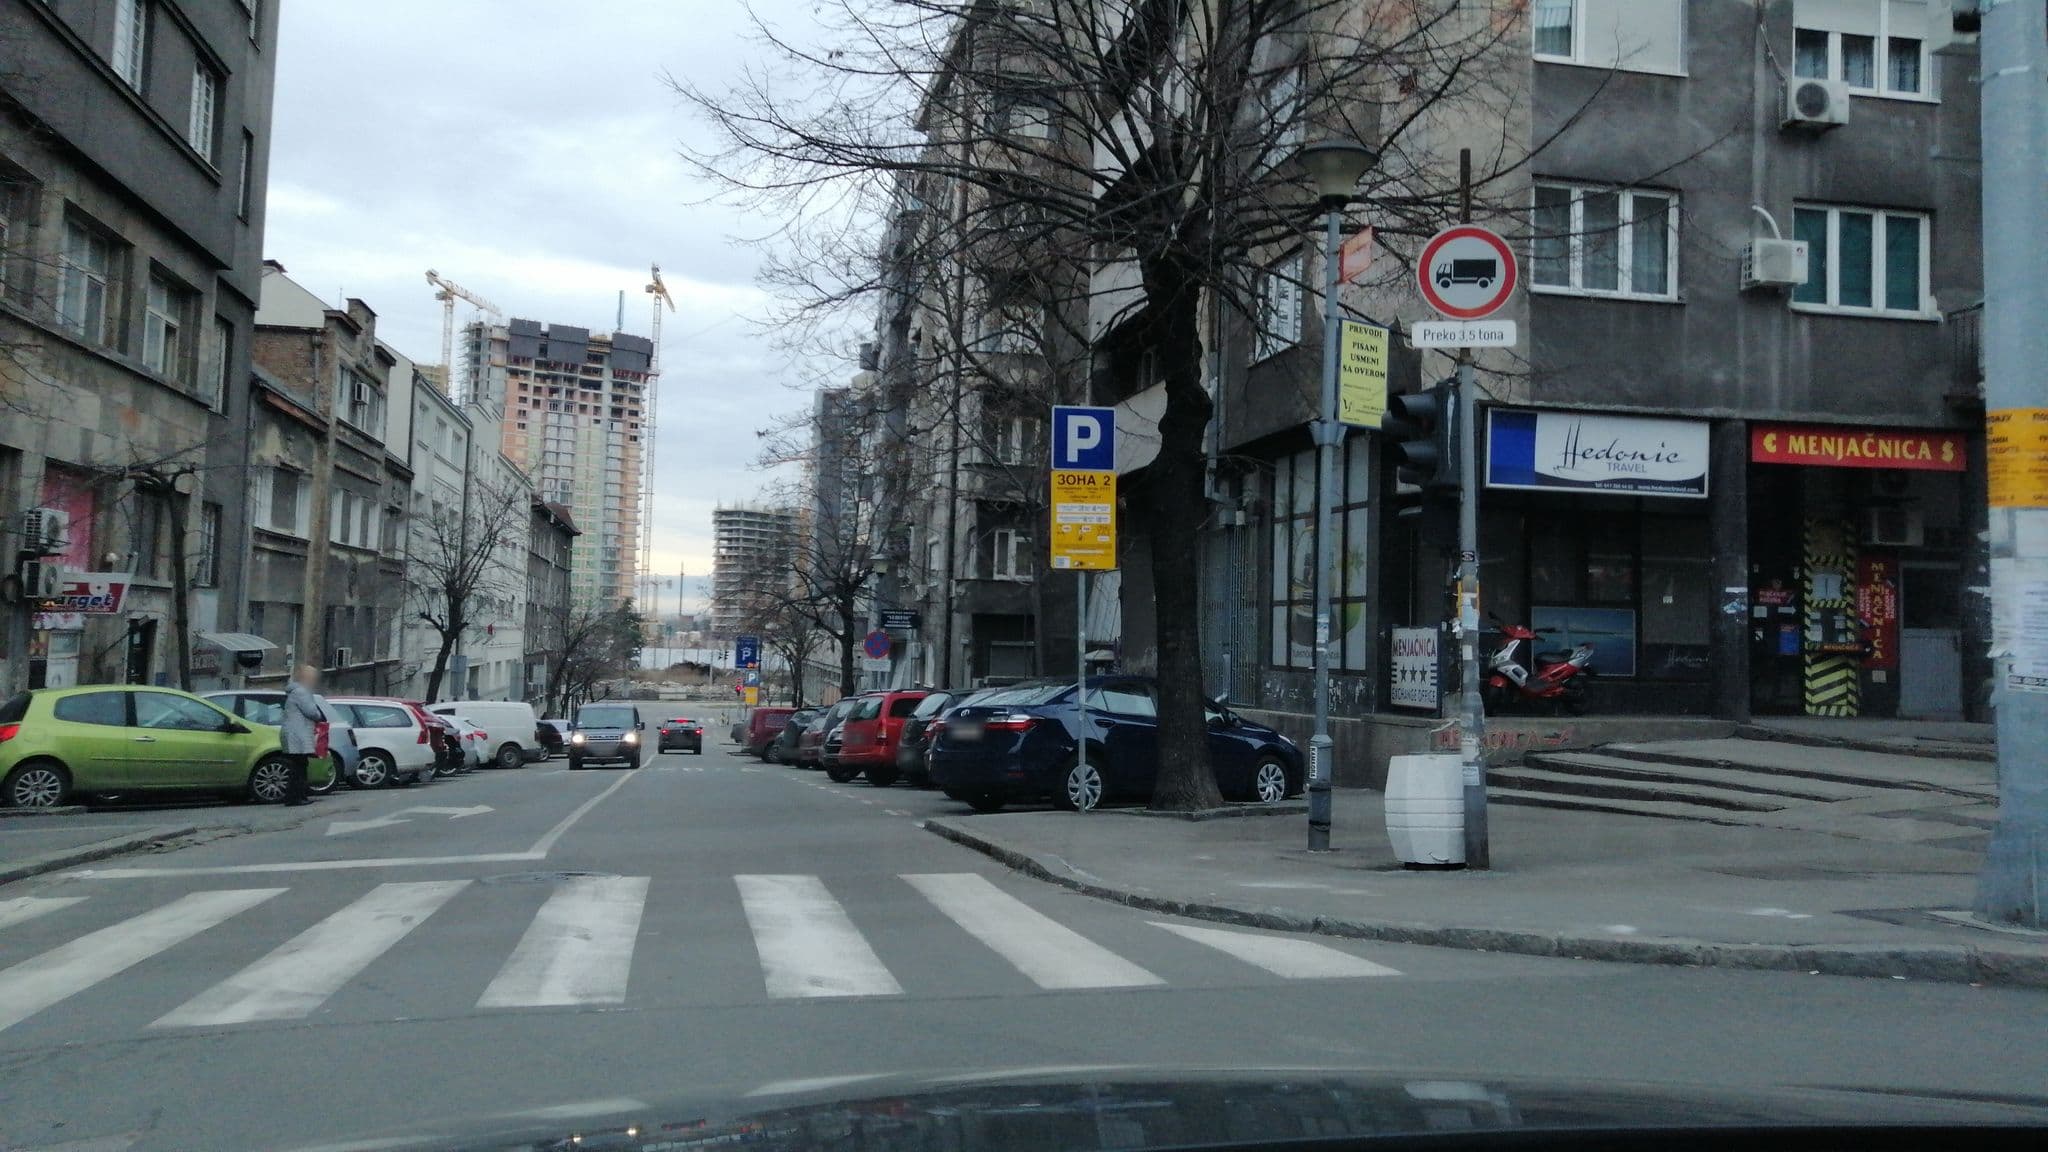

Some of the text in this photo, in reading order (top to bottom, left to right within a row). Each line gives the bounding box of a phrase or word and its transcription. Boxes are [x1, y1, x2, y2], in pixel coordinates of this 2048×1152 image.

[1349, 325, 1383, 338] PREVODI
[1423, 328, 1504, 342] Preko 3,5 tona
[1352, 341, 1378, 353] PISANI
[1350, 353, 1379, 366] USMENI
[1343, 365, 1386, 378] SA OVEROM
[1066, 414, 1102, 463] P
[1557, 418, 1684, 470] Hedonic
[1787, 431, 1933, 461] MENJAČNICA
[1607, 461, 1648, 473] TRAVEL
[1057, 474, 1111, 487] ЗОНА 2
[1392, 634, 1437, 657] MENJAČNICA
[1391, 687, 1436, 703] EXCHANGE OFFICE
